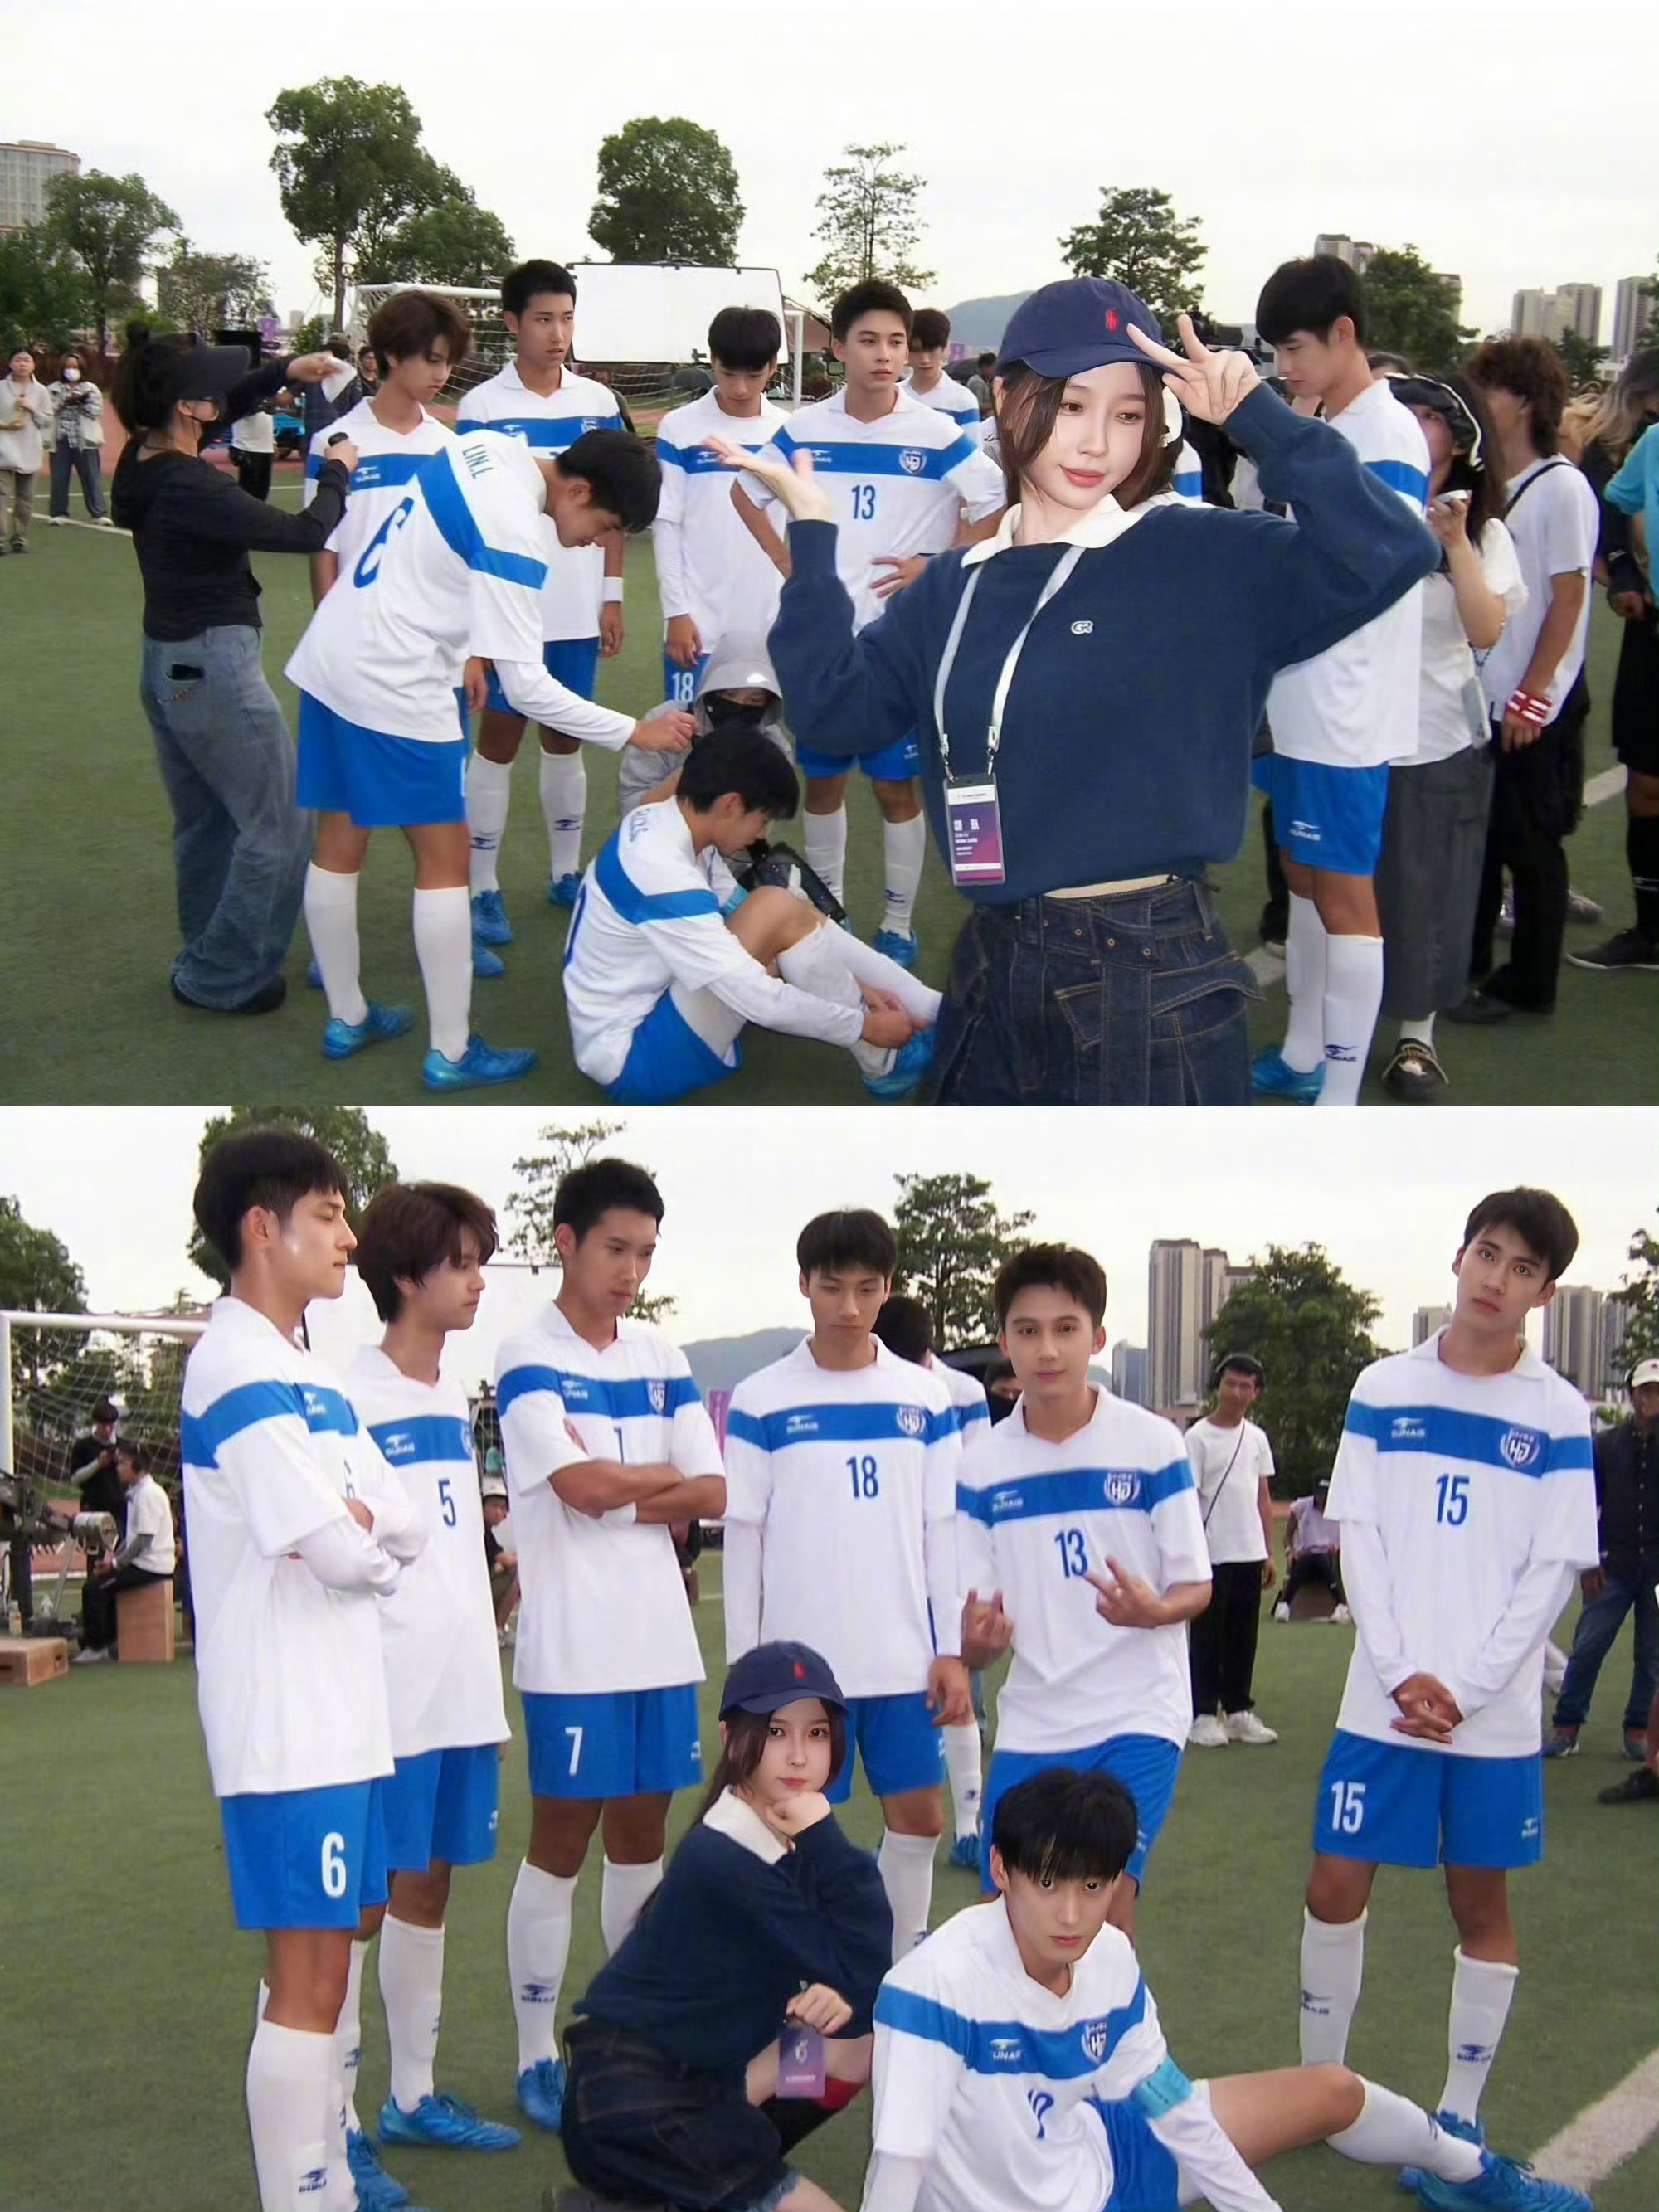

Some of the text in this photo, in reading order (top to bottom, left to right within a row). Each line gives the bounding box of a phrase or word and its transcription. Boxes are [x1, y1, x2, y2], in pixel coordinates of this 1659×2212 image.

[851, 484, 876, 520] 13
[353, 496, 415, 589] 6
[672, 672, 694, 702] 18
[846, 1455, 879, 1499] 18
[1436, 1473, 1470, 1526] 15
[438, 1478, 457, 1527] 5
[1054, 1529, 1088, 1578] 13
[564, 1726, 583, 1777] 7
[1331, 1780, 1366, 1834] 15
[321, 1831, 347, 1898] 6
